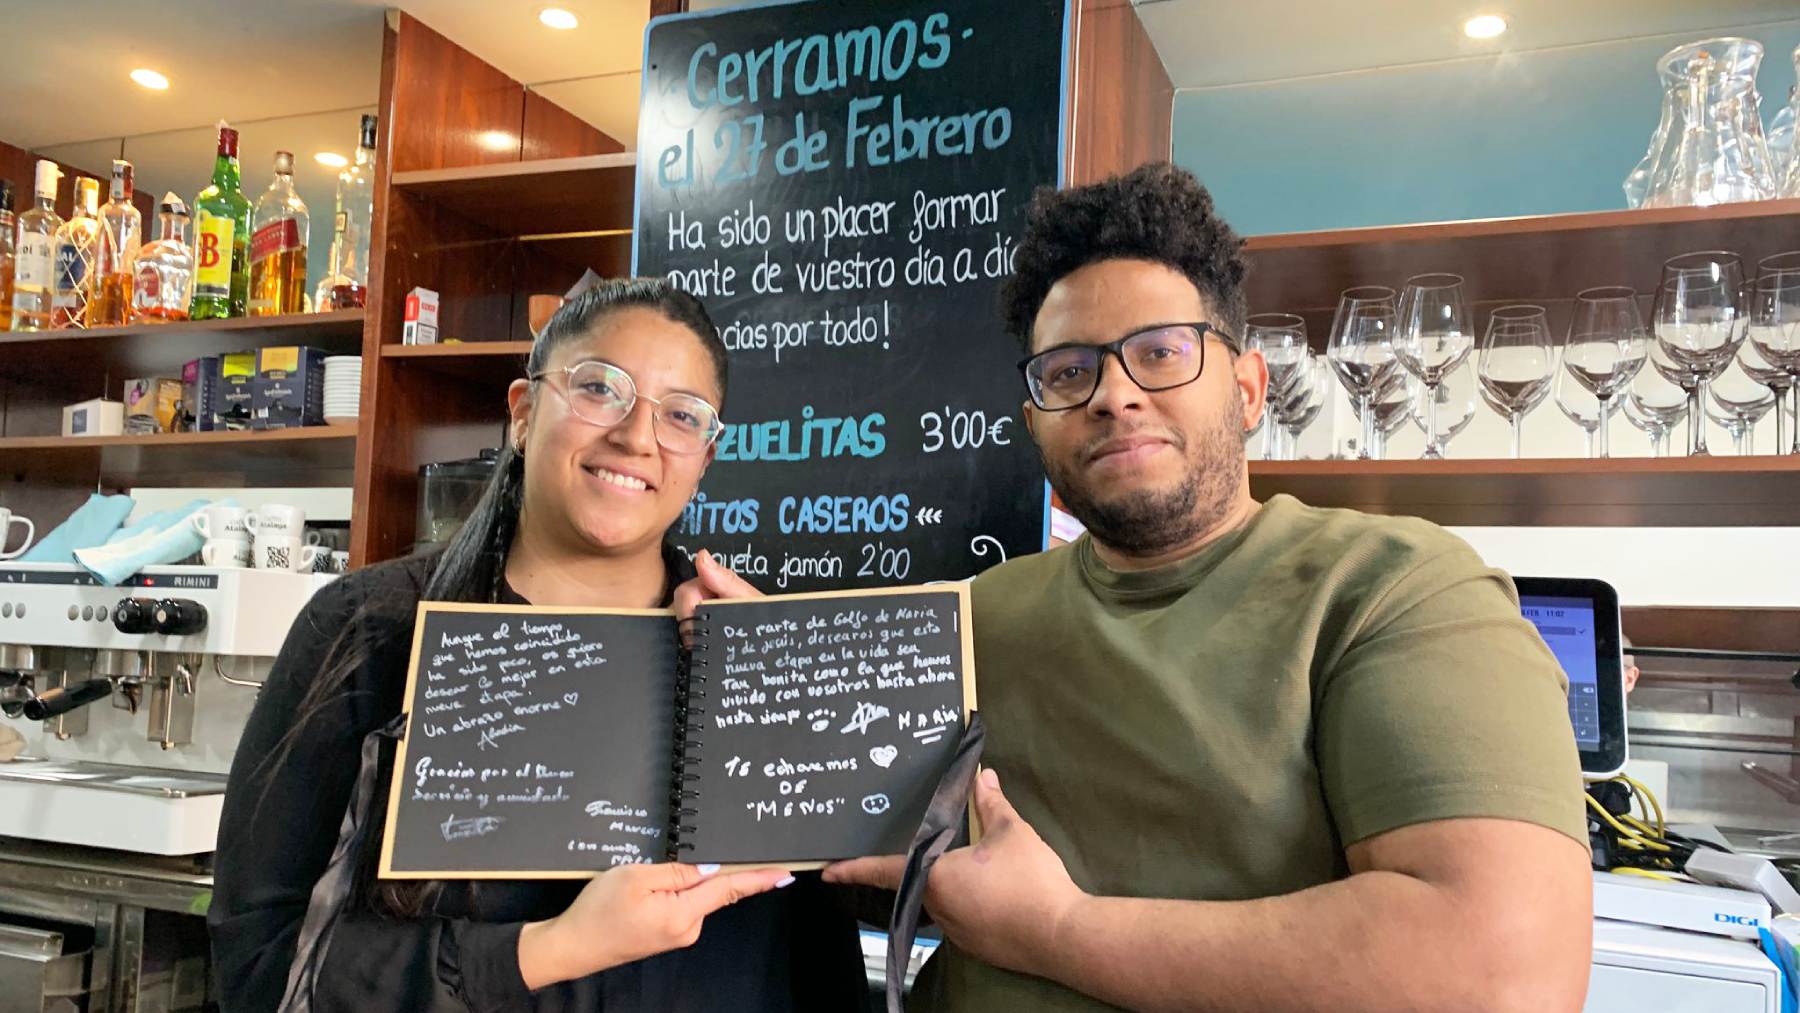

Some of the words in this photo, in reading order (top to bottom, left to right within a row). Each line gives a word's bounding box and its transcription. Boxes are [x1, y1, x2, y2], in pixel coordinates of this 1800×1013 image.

[657, 129, 695, 190] el
[713, 112, 769, 185] 27
[775, 110, 830, 176] de
[845, 94, 1012, 170] Febrero
[668, 212, 706, 251] Ha
[719, 200, 770, 248] sido
[785, 208, 815, 244] un
[822, 195, 897, 258] placer
[909, 188, 1007, 245] formar
[668, 258, 737, 298] parte
[752, 250, 783, 294] de
[795, 256, 896, 294] vuestro
[905, 245, 948, 287] día
[954, 248, 978, 281] a
[715, 320, 768, 351] cias
[772, 321, 814, 364] por
[820, 300, 891, 350] todo!
[779, 493, 911, 535] CASEROS
[174, 576, 211, 588] RIMINI
[776, 550, 843, 588] jamón
[492, 623, 511, 640] el
[521, 620, 563, 638] tiempo
[723, 626, 749, 639] De
[756, 618, 799, 637] parte
[806, 615, 828, 630] de
[875, 608, 890, 624] de
[432, 653, 456, 667] que
[465, 645, 508, 660] hemos
[725, 660, 766, 676] nueva
[776, 651, 813, 670] etapa
[820, 650, 837, 664] en
[841, 646, 855, 661] la
[860, 643, 890, 660] vida
[726, 644, 737, 662] y
[742, 640, 756, 655] de
[808, 628, 874, 646] desearos
[880, 627, 905, 642] que
[425, 684, 470, 700] desear
[501, 669, 538, 688] mejor
[548, 665, 567, 676] en
[428, 670, 446, 683] ha
[458, 661, 488, 676] sido
[542, 651, 560, 661] os
[761, 669, 808, 687] bonita
[814, 666, 849, 682] como
[857, 662, 875, 676] la
[880, 661, 905, 678] que
[721, 688, 767, 709] vivido
[775, 687, 801, 702] con
[807, 679, 870, 697] vosotros
[877, 674, 915, 690] hasta
[917, 667, 956, 685] ahora
[423, 723, 447, 738] Un
[452, 710, 504, 733] abrazo
[513, 701, 562, 716] enorme
[715, 709, 755, 728] hasta
[415, 756, 476, 788] Gracias
[481, 768, 509, 782] por
[515, 763, 532, 778] el
[763, 757, 859, 778] echaremos
[1714, 912, 1759, 927] DIGI
